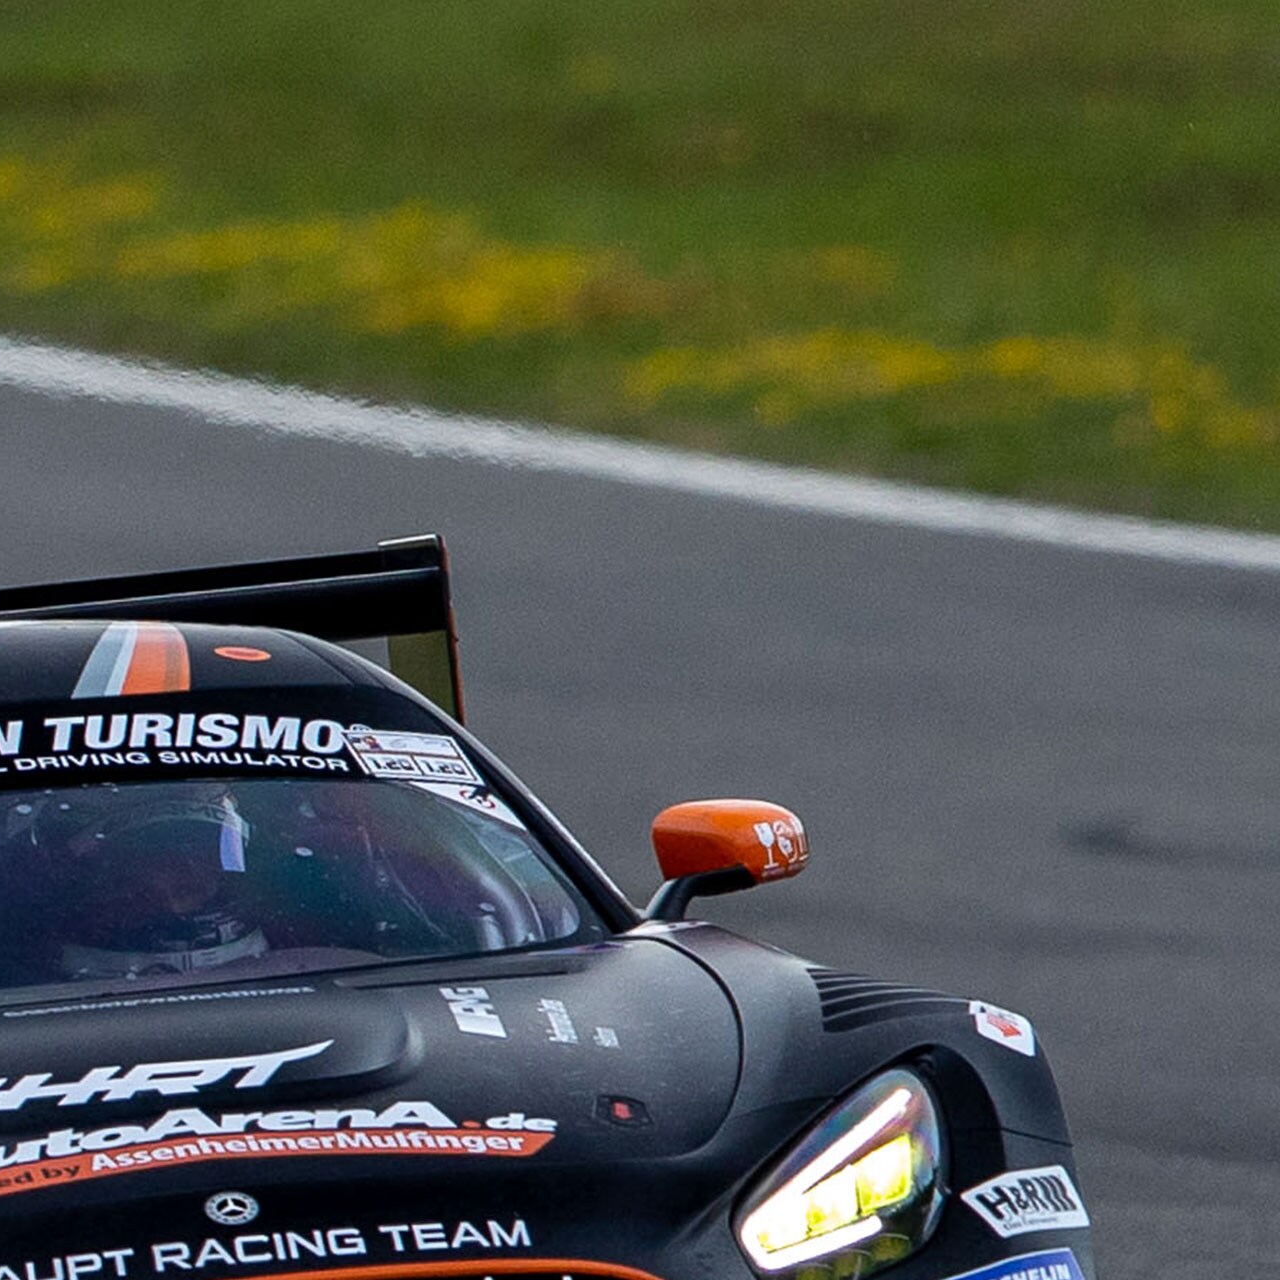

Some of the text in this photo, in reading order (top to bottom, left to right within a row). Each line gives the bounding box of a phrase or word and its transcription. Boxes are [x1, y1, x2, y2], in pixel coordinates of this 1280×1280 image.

[44, 712, 347, 756] TURISMO
[14, 752, 150, 773] DRIVING
[160, 749, 350, 773] SIMULATOR
[40, 1161, 81, 1184] by
[91, 1130, 525, 1172] AssenheimerMulfinger
[153, 1228, 368, 1272] RACING
[381, 1219, 532, 1253] TEAM
